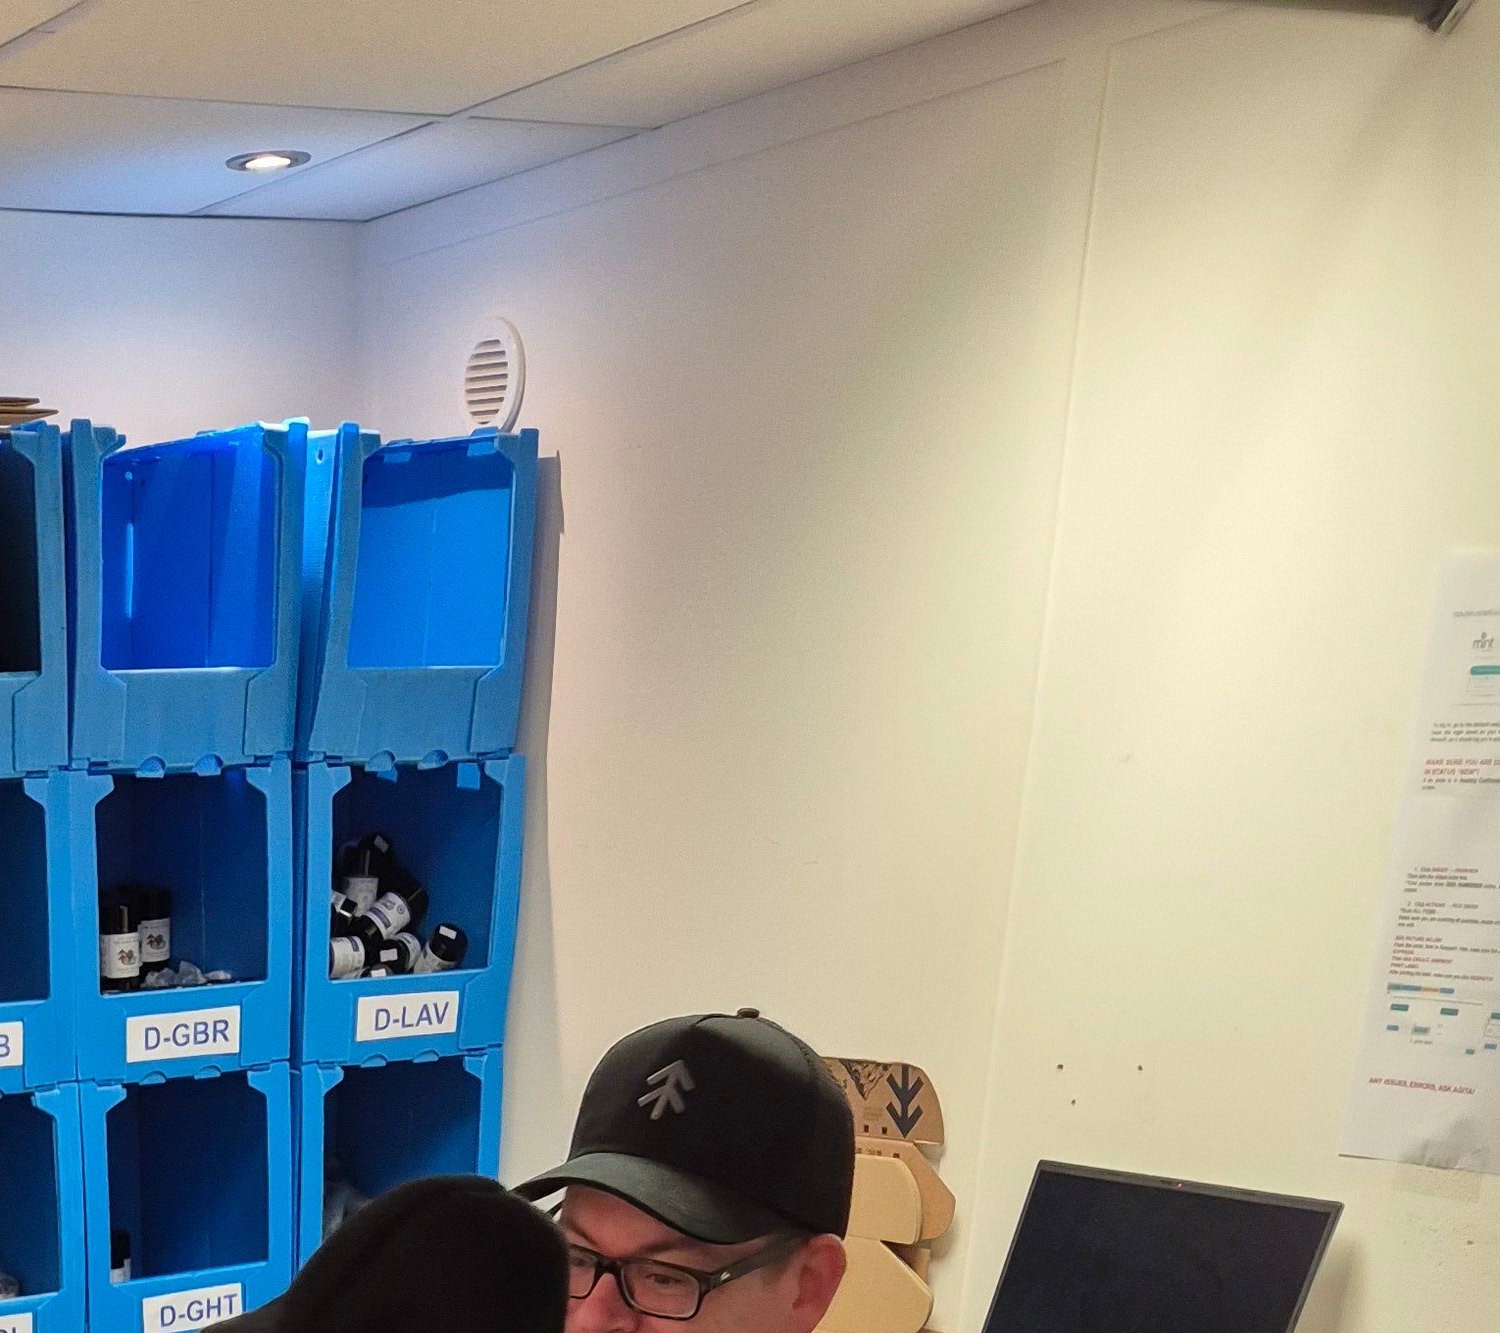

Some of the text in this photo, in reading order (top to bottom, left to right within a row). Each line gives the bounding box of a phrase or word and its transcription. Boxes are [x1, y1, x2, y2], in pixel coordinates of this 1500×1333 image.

[373, 1002, 450, 1033] D-LAV
[143, 1018, 231, 1052] D-GBR
[159, 1293, 237, 1329] D-GHT
